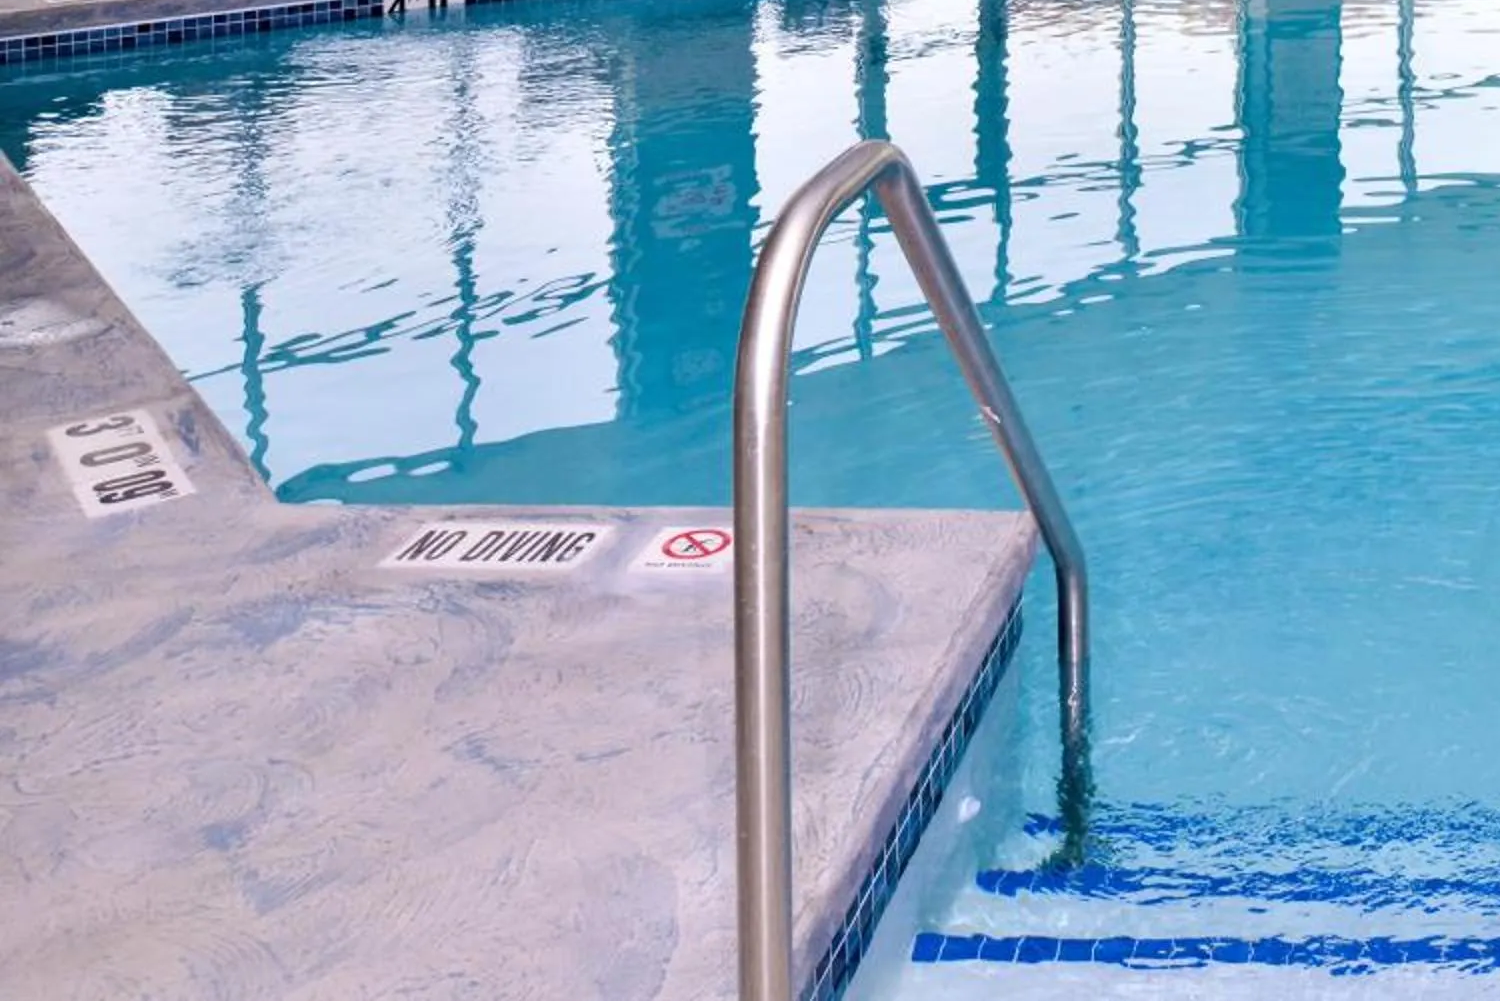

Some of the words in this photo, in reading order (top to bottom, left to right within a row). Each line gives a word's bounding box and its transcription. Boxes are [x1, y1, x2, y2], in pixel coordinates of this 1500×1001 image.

[65, 416, 135, 437] 3
[396, 530, 468, 561] NO
[458, 530, 596, 562] DIVING
